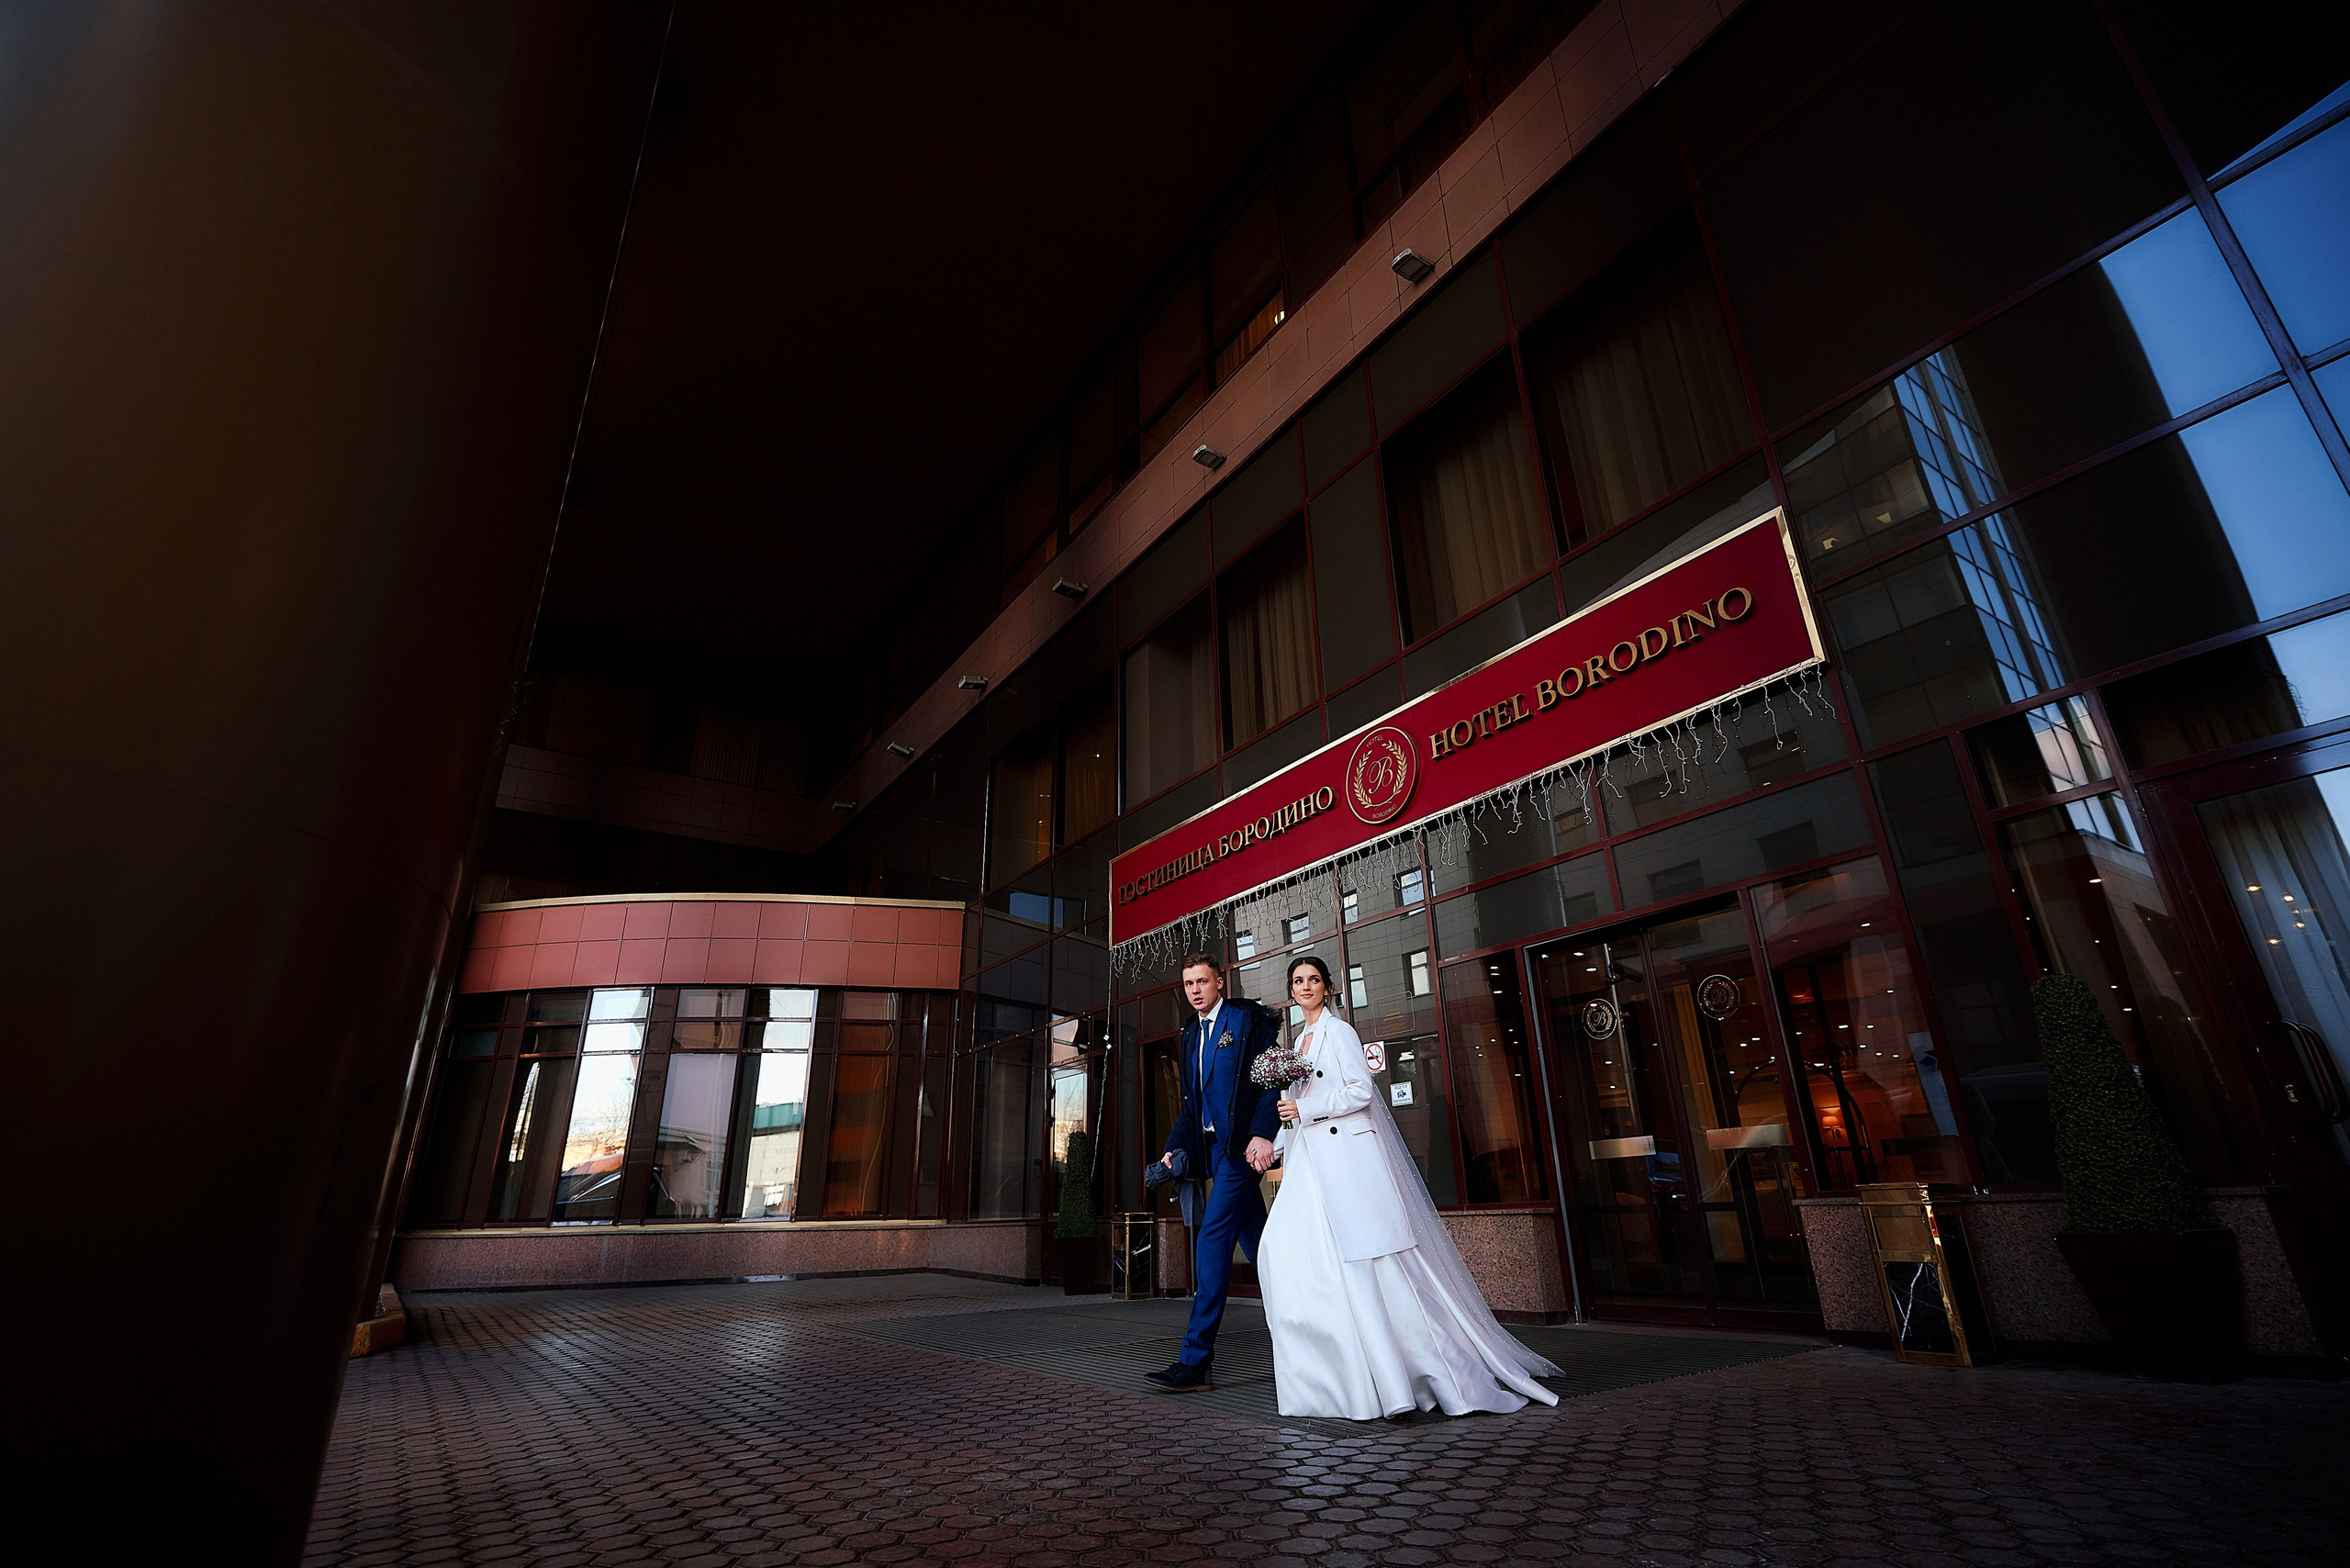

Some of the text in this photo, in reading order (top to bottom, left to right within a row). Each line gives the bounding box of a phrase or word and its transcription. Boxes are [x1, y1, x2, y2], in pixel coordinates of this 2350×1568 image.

[1428, 587, 1752, 760] HOTEL BORODINO
[1366, 734, 1384, 748] HOTEL
[1371, 803, 1397, 819] BORODINO
[1118, 786, 1334, 905] ГОСТИНИЦА БОРОДИНО
